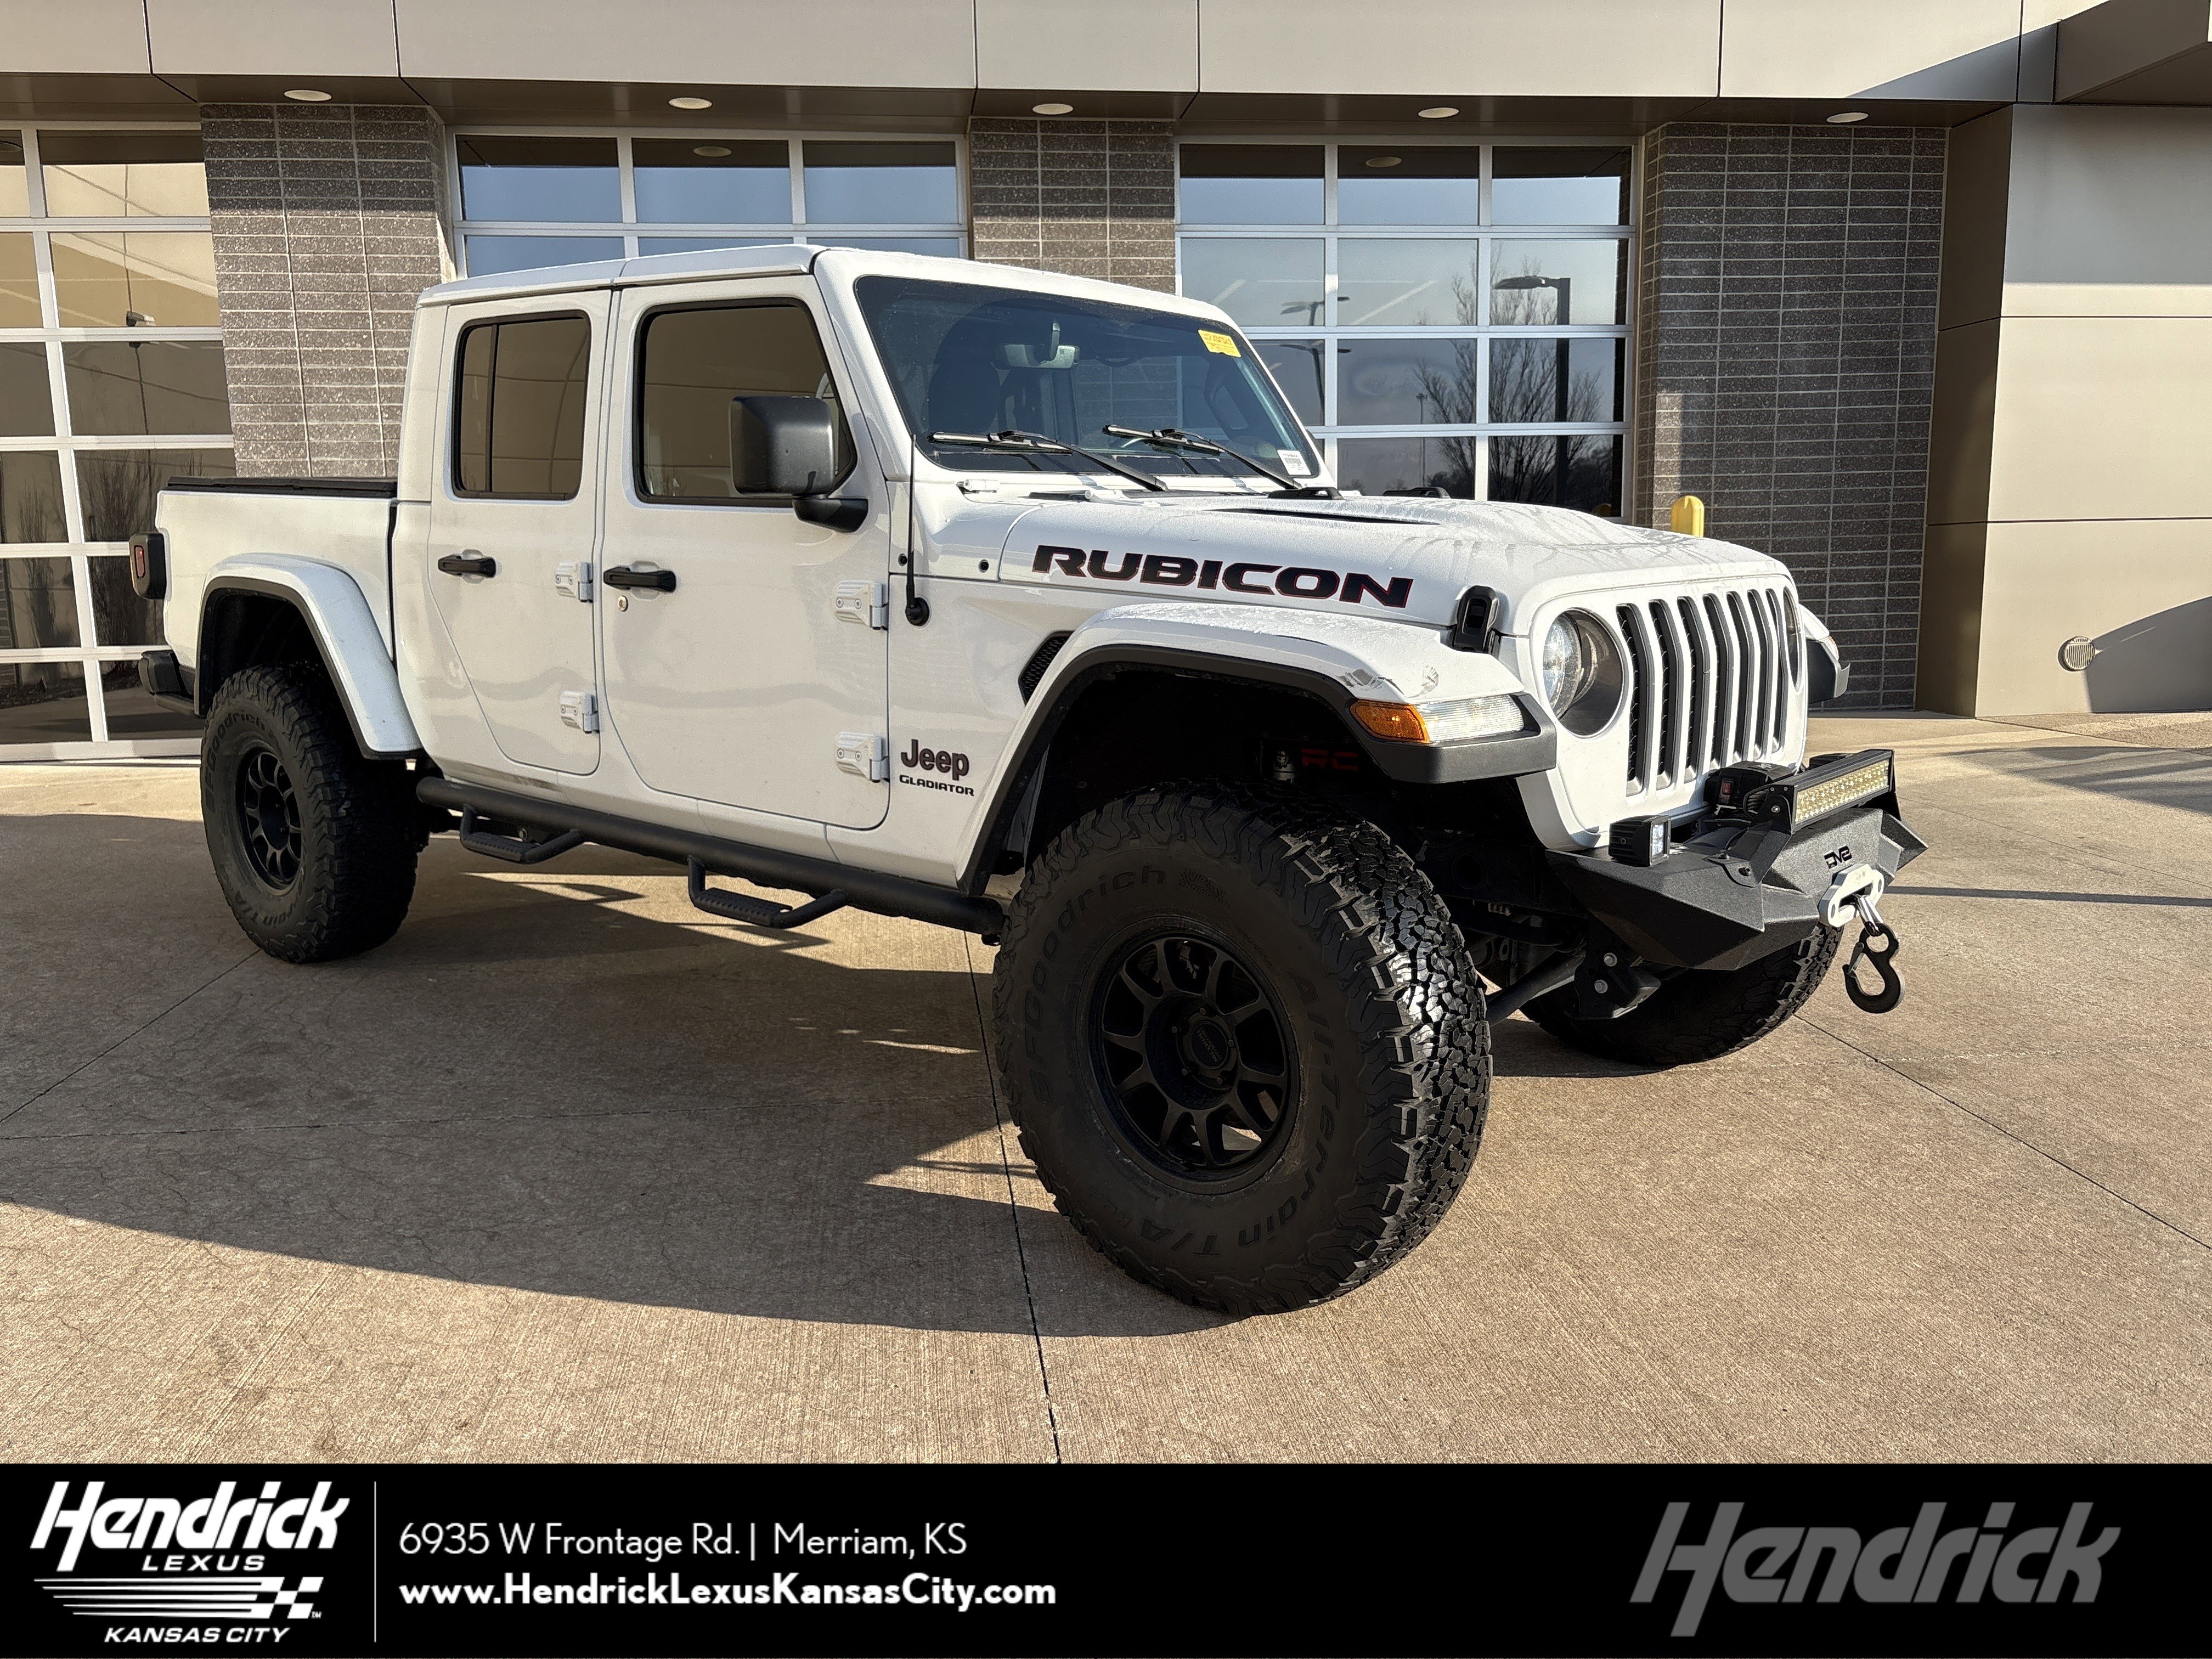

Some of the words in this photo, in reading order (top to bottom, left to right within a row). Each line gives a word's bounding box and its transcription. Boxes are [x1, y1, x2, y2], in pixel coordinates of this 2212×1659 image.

[1032, 544, 1414, 608] RUBICON
[205, 711, 266, 813] BFGoodrich
[899, 774, 975, 797] GLADIATOR
[900, 738, 969, 781] Jeep
[1024, 865, 1166, 1104] BFGoodrich
[1140, 1217, 1221, 1257] T/A
